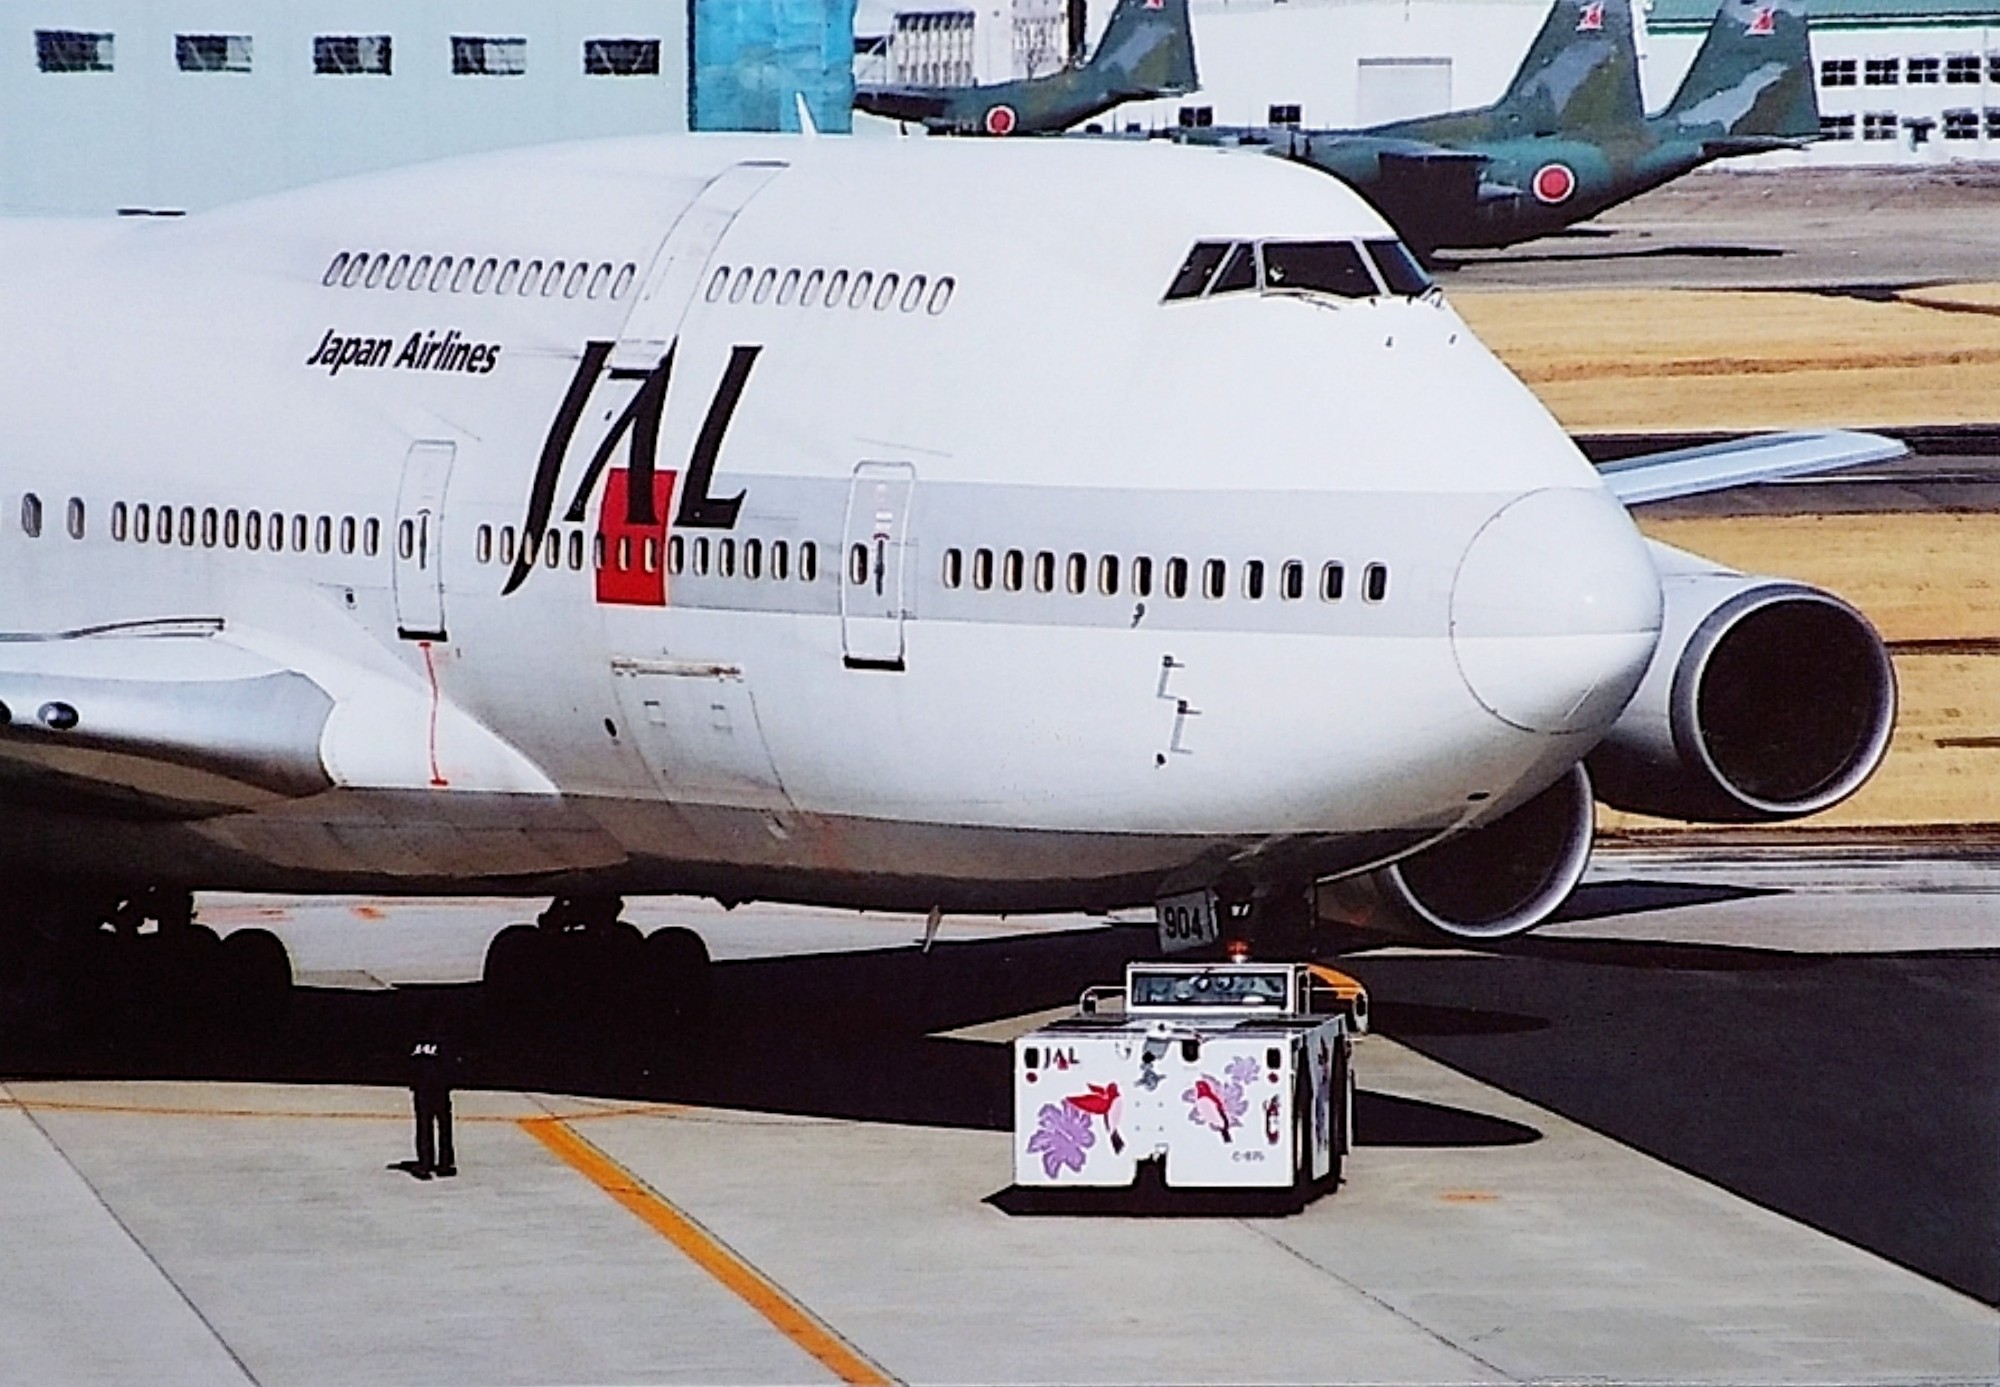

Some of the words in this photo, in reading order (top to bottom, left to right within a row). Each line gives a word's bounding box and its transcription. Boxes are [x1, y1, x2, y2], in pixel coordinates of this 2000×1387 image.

[306, 329, 392, 376] Japan
[393, 330, 500, 373] Airlines
[501, 335, 763, 597] JAL
[1165, 906, 1203, 940] 904
[1043, 1046, 1080, 1070] JAL
